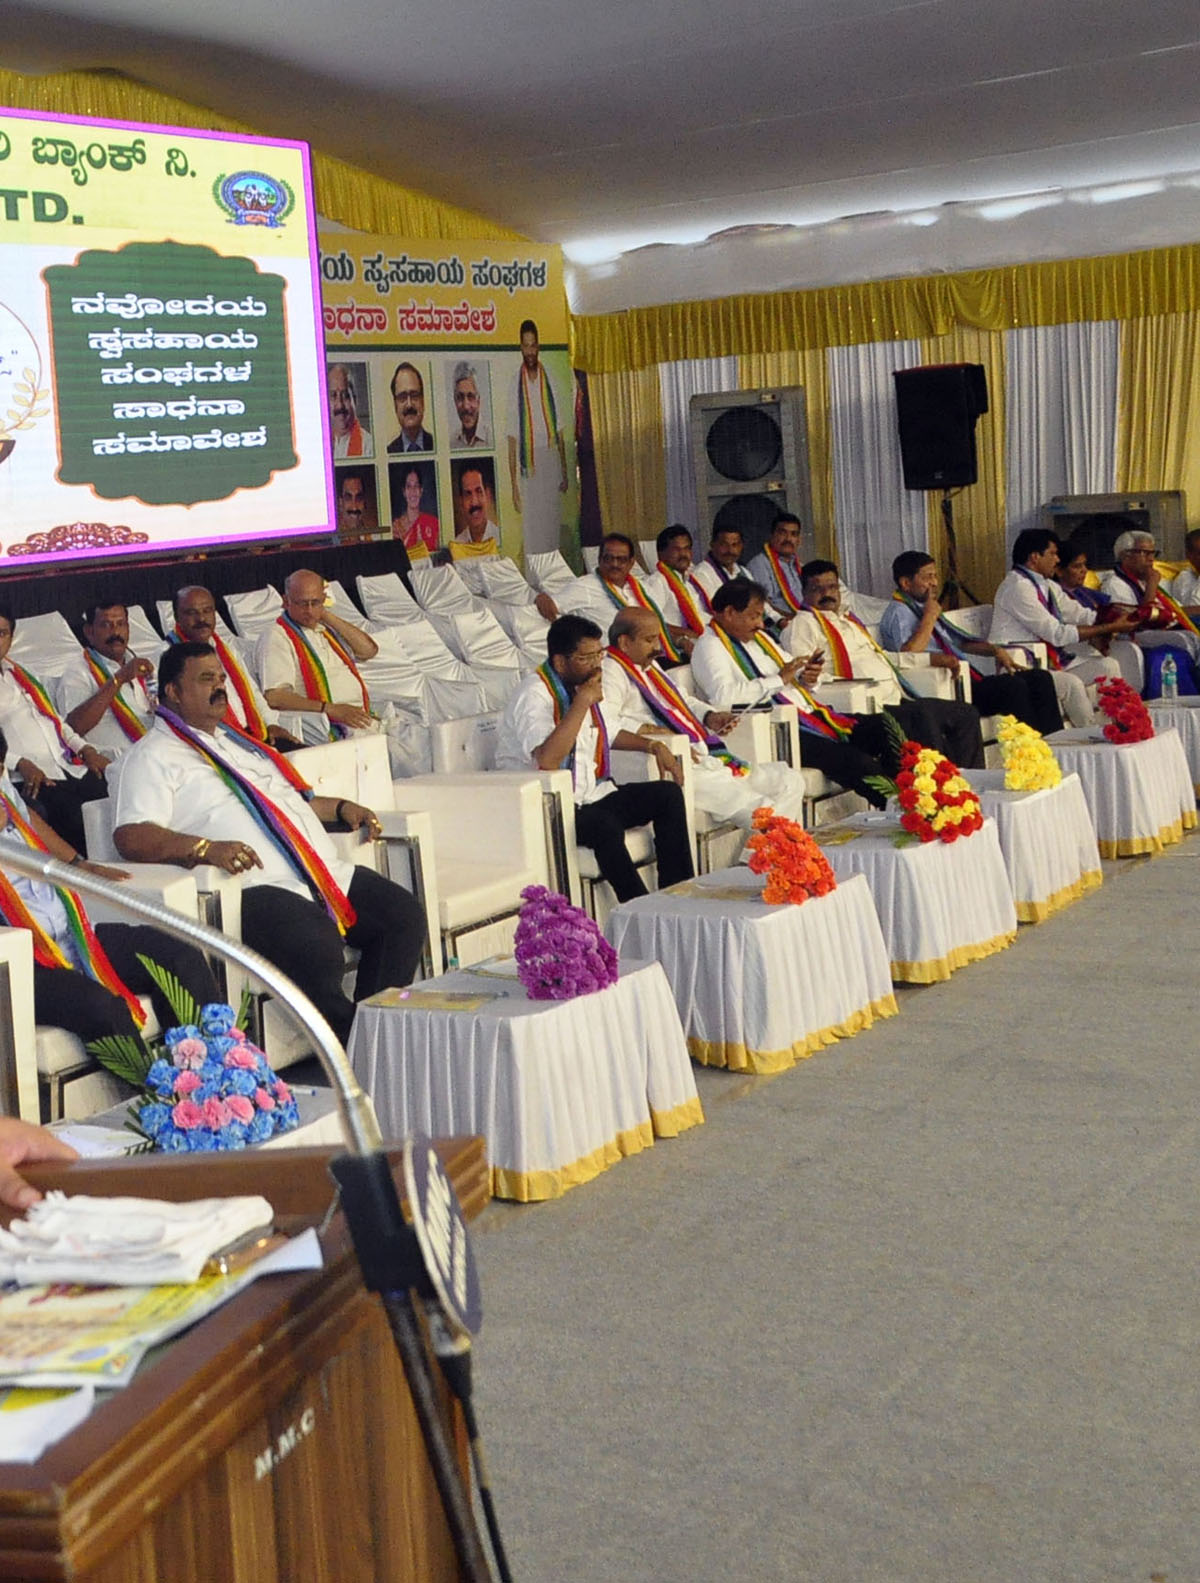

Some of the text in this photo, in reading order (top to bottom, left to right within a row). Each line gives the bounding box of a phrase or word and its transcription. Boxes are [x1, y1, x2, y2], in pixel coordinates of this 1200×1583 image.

[32, 136, 146, 187] ಬ್ಯಾಂಕ್
[165, 148, 196, 178] ನಿ.
[319, 252, 546, 293] ಯ ಸ್ವಸಹಾಯ ಸಂಘಗಳ
[71, 292, 267, 319] ನವೋದಯ
[400, 302, 495, 332] ಸಮಾವೇಶ
[88, 327, 259, 359] ಸ್ವಸಹಾಯ
[101, 361, 252, 386] ಸಂಘಗಳ
[113, 395, 246, 420] ಸಾಧನಾ
[92, 426, 267, 455] ಸಮಾವೇಶ
